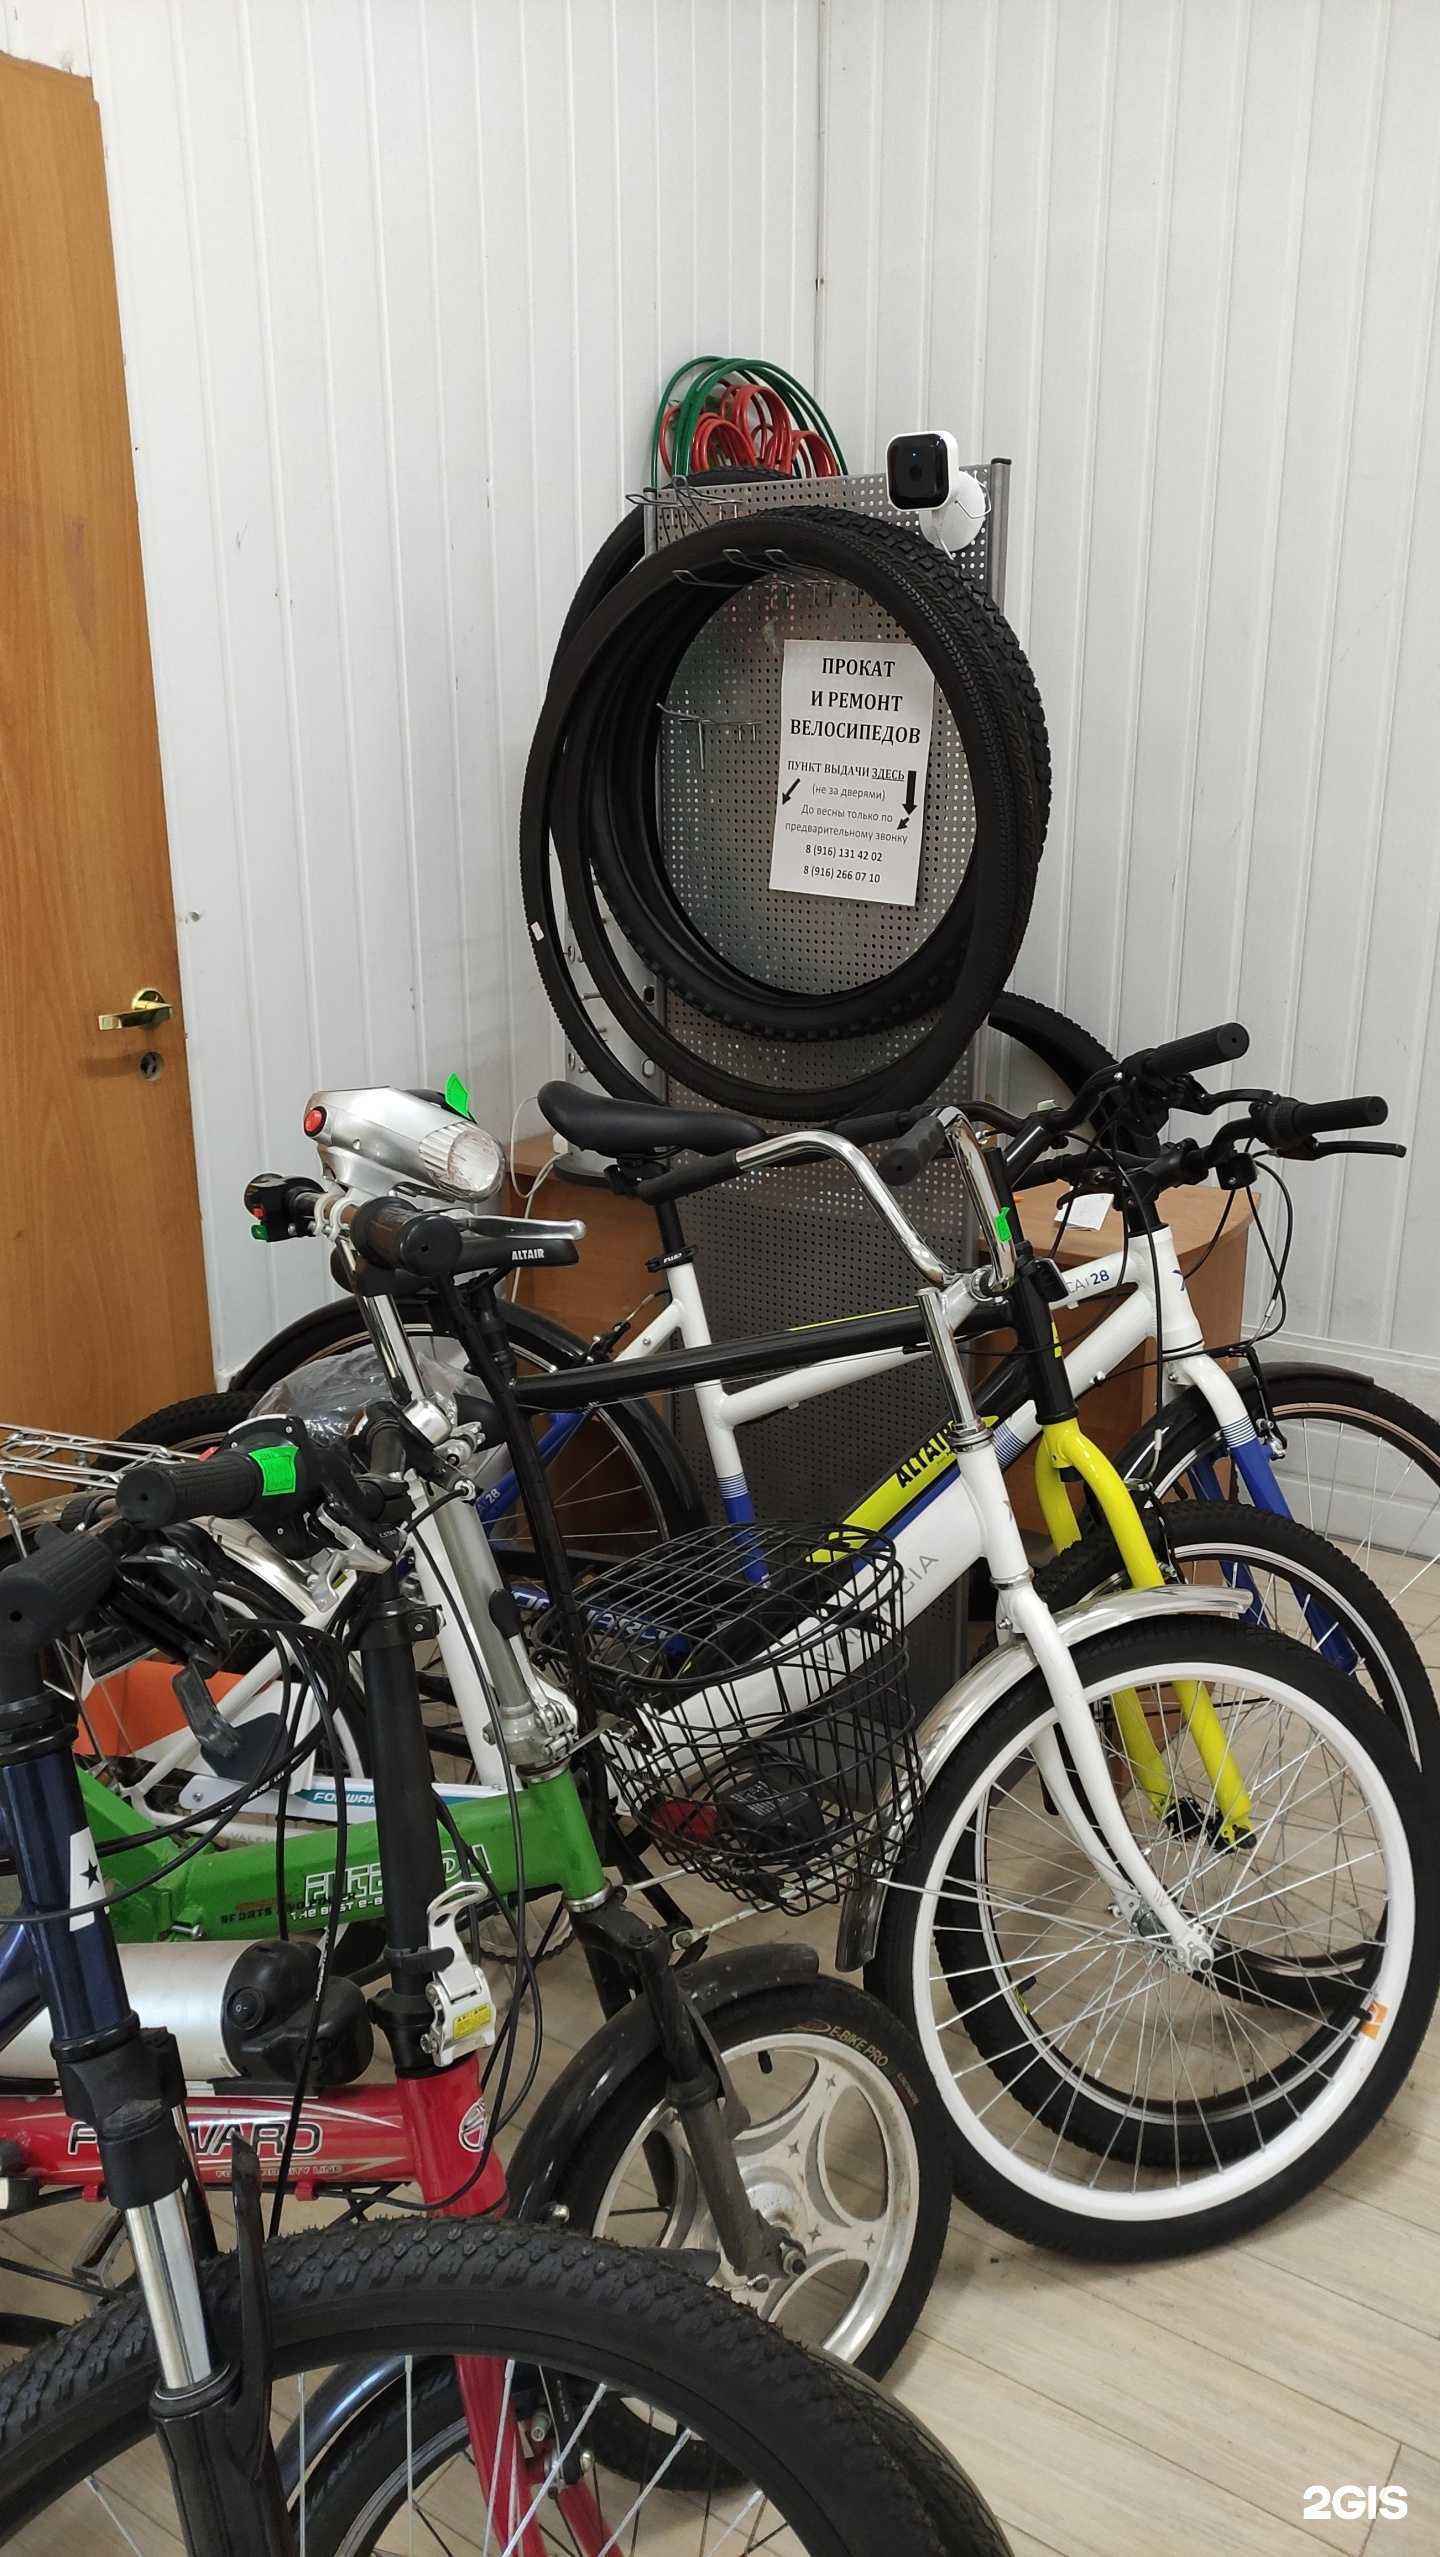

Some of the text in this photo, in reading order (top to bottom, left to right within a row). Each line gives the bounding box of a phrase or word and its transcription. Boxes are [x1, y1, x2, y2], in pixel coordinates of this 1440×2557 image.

[822, 657, 895, 678] ПРОКАТ
[811, 690, 903, 712] И РЕМОНТ
[790, 718, 921, 745] ВЕЛОСИПЕДОВ
[787, 760, 905, 781] ПУНКТ ВЫДАЧИ ЗДЕСЬ
[812, 784, 885, 801] (не за дверями)
[800, 804, 893, 823] До весны только по
[785, 822, 908, 844] предварительному звонку
[805, 844, 882, 862] 8 (916) 131 42 02
[803, 865, 880, 883] 8 (916) 266 07 10
[511, 1248, 545, 1261] ALTAIR
[1089, 1269, 1110, 1286] 28
[487, 1488, 501, 1504] 28
[862, 2044, 889, 2067] PRO
